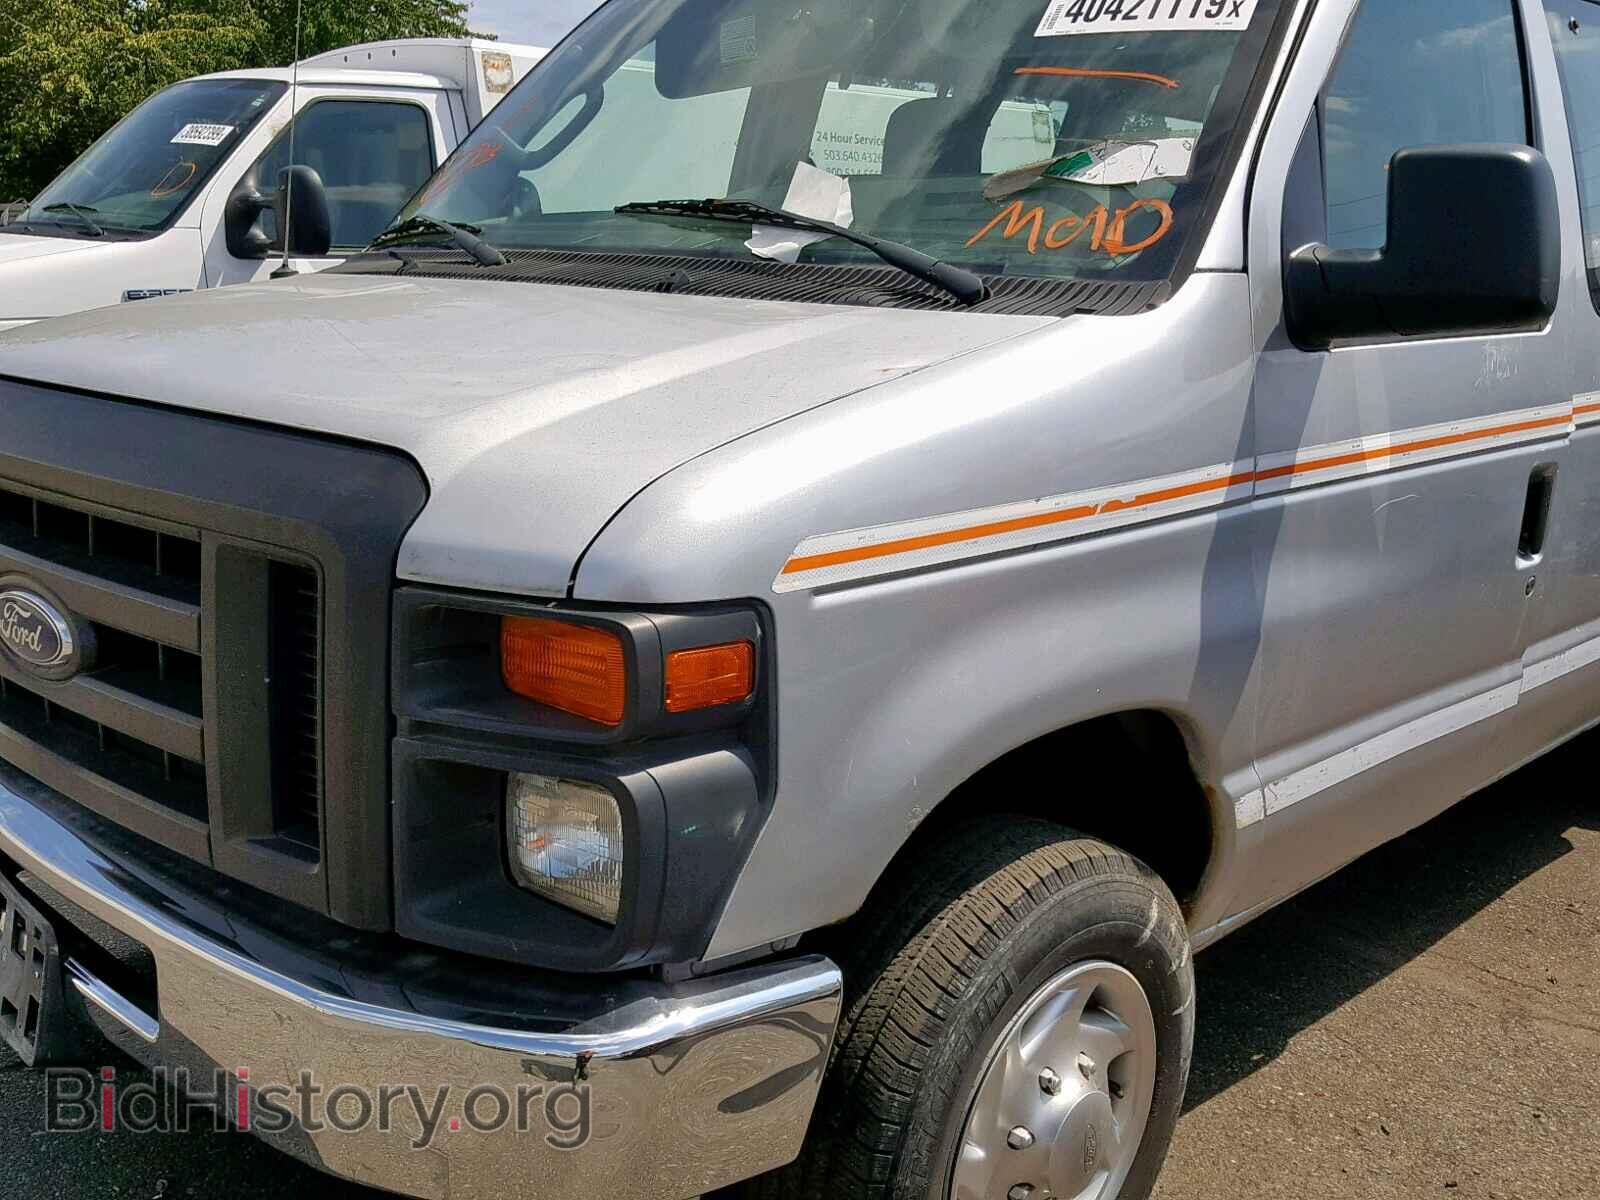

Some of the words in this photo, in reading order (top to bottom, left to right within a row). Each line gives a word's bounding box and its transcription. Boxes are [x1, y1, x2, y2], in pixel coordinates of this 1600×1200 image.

[816, 131, 828, 143] 24
[830, 132, 853, 145] Hour
[1, 601, 43, 652] Ford
